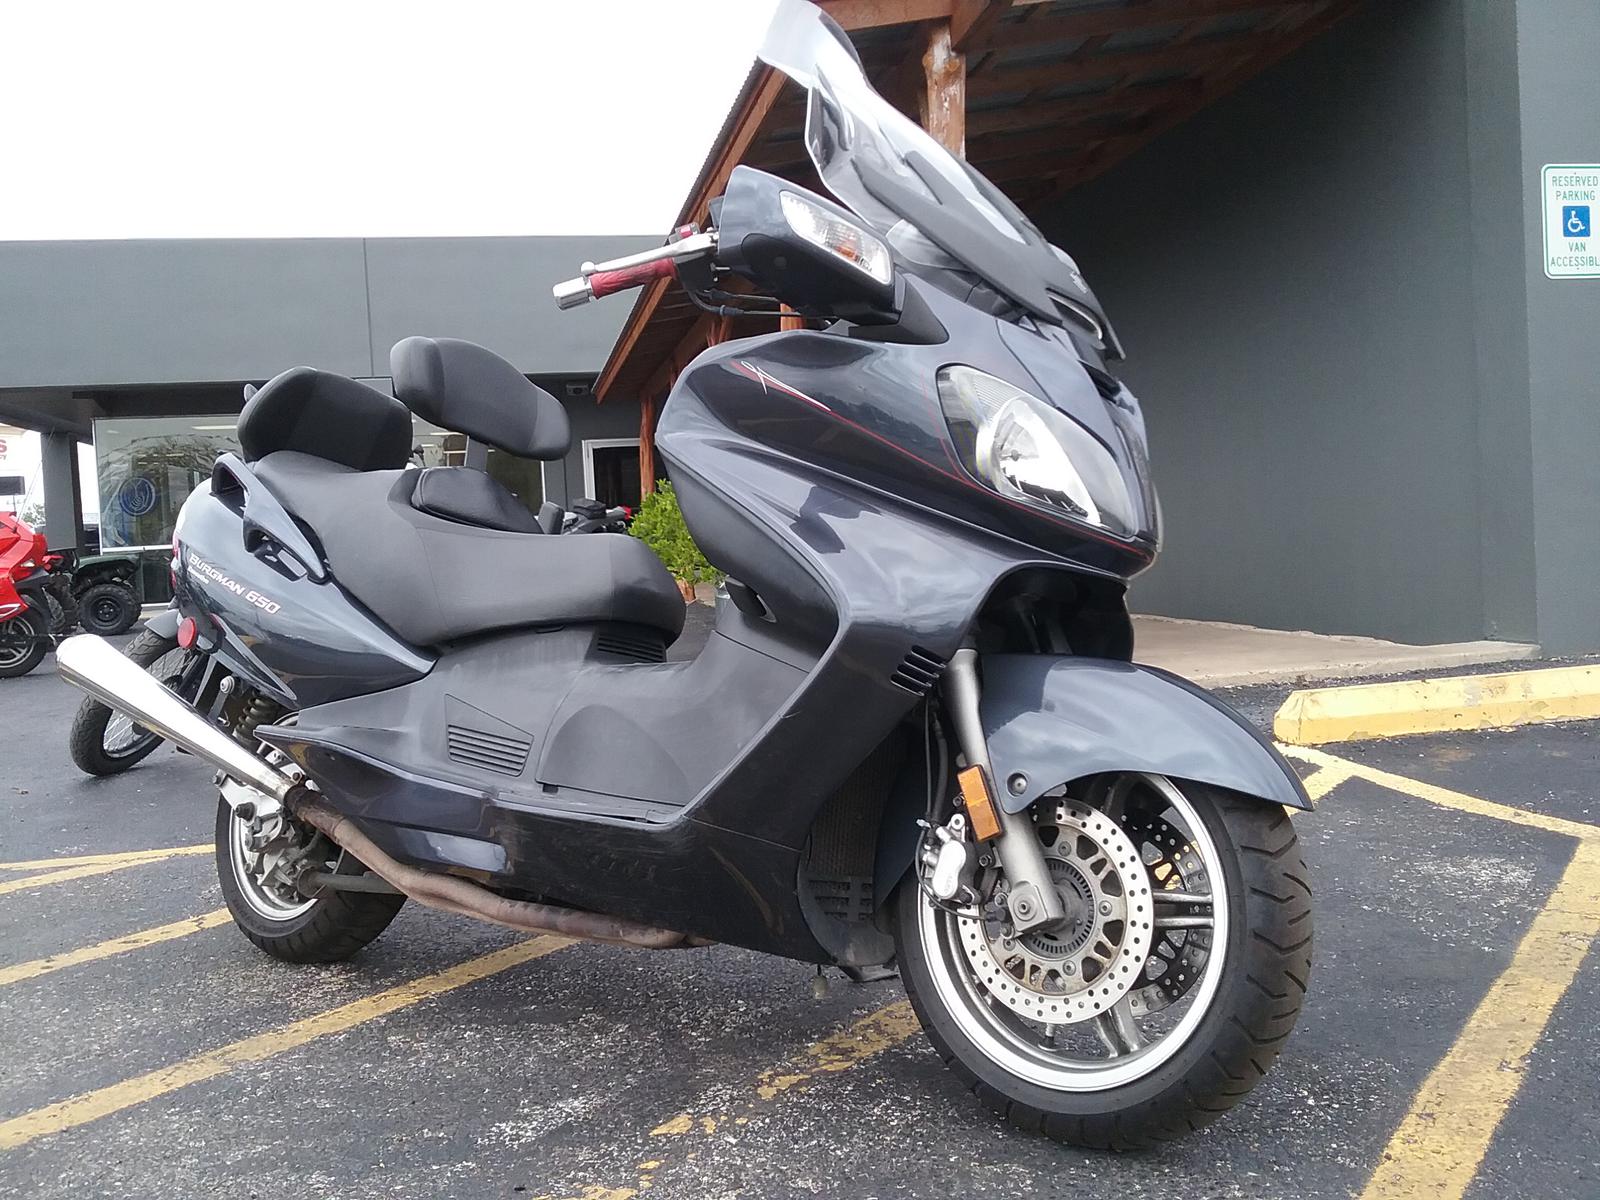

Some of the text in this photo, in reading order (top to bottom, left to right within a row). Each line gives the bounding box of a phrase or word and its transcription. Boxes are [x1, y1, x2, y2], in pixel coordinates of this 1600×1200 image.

[1551, 175, 1599, 187] RESERVED
[1555, 190, 1596, 201] PARKING
[1568, 241, 1586, 252] VAN
[1550, 255, 1600, 267] ACCESSIBL
[189, 552, 245, 596] BURGMAN
[245, 590, 281, 615] 650
